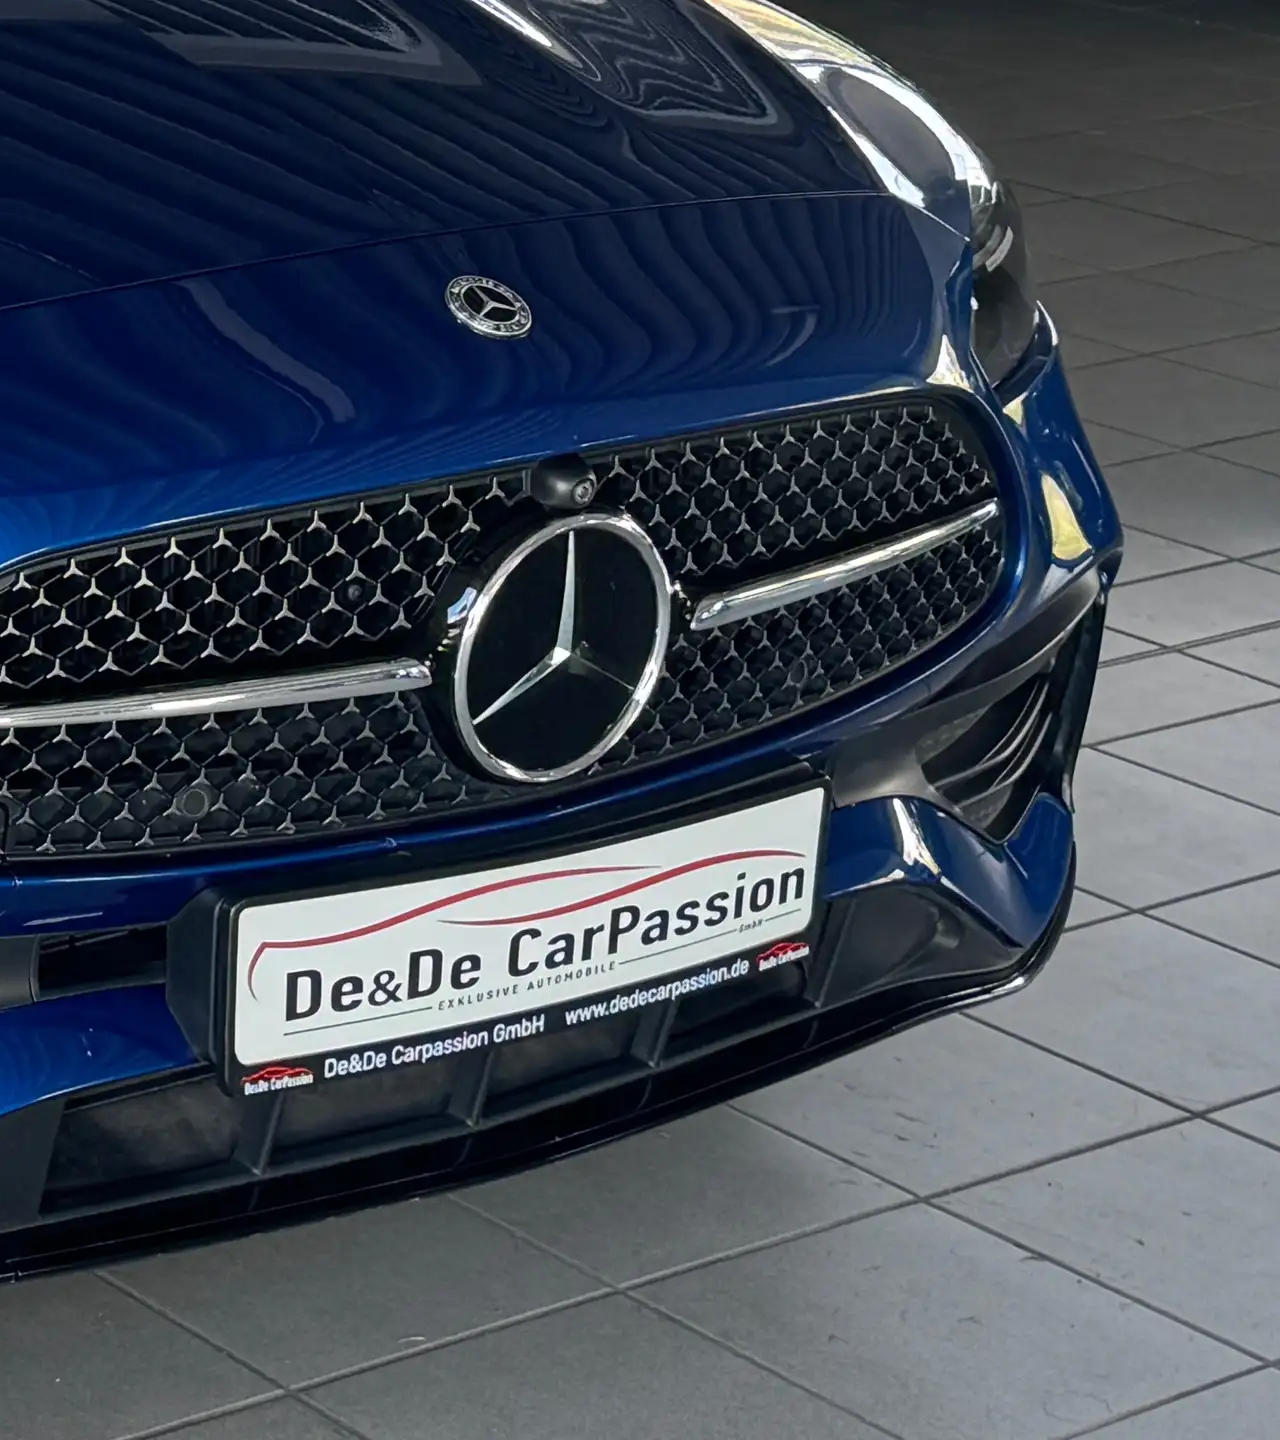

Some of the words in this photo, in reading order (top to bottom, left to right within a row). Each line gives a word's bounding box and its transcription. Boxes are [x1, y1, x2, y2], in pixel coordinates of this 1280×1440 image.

[285, 949, 481, 1022] De&De
[508, 868, 805, 977] CarPassion
[438, 984, 520, 1011] EXKLUSIVE
[526, 960, 616, 991] AUTOMOBILE
[564, 958, 750, 1026] www.dedecarpassion.de
[323, 1050, 387, 1079] De&De
[391, 1030, 489, 1065] Carpassion
[492, 1014, 545, 1043] GmbH
